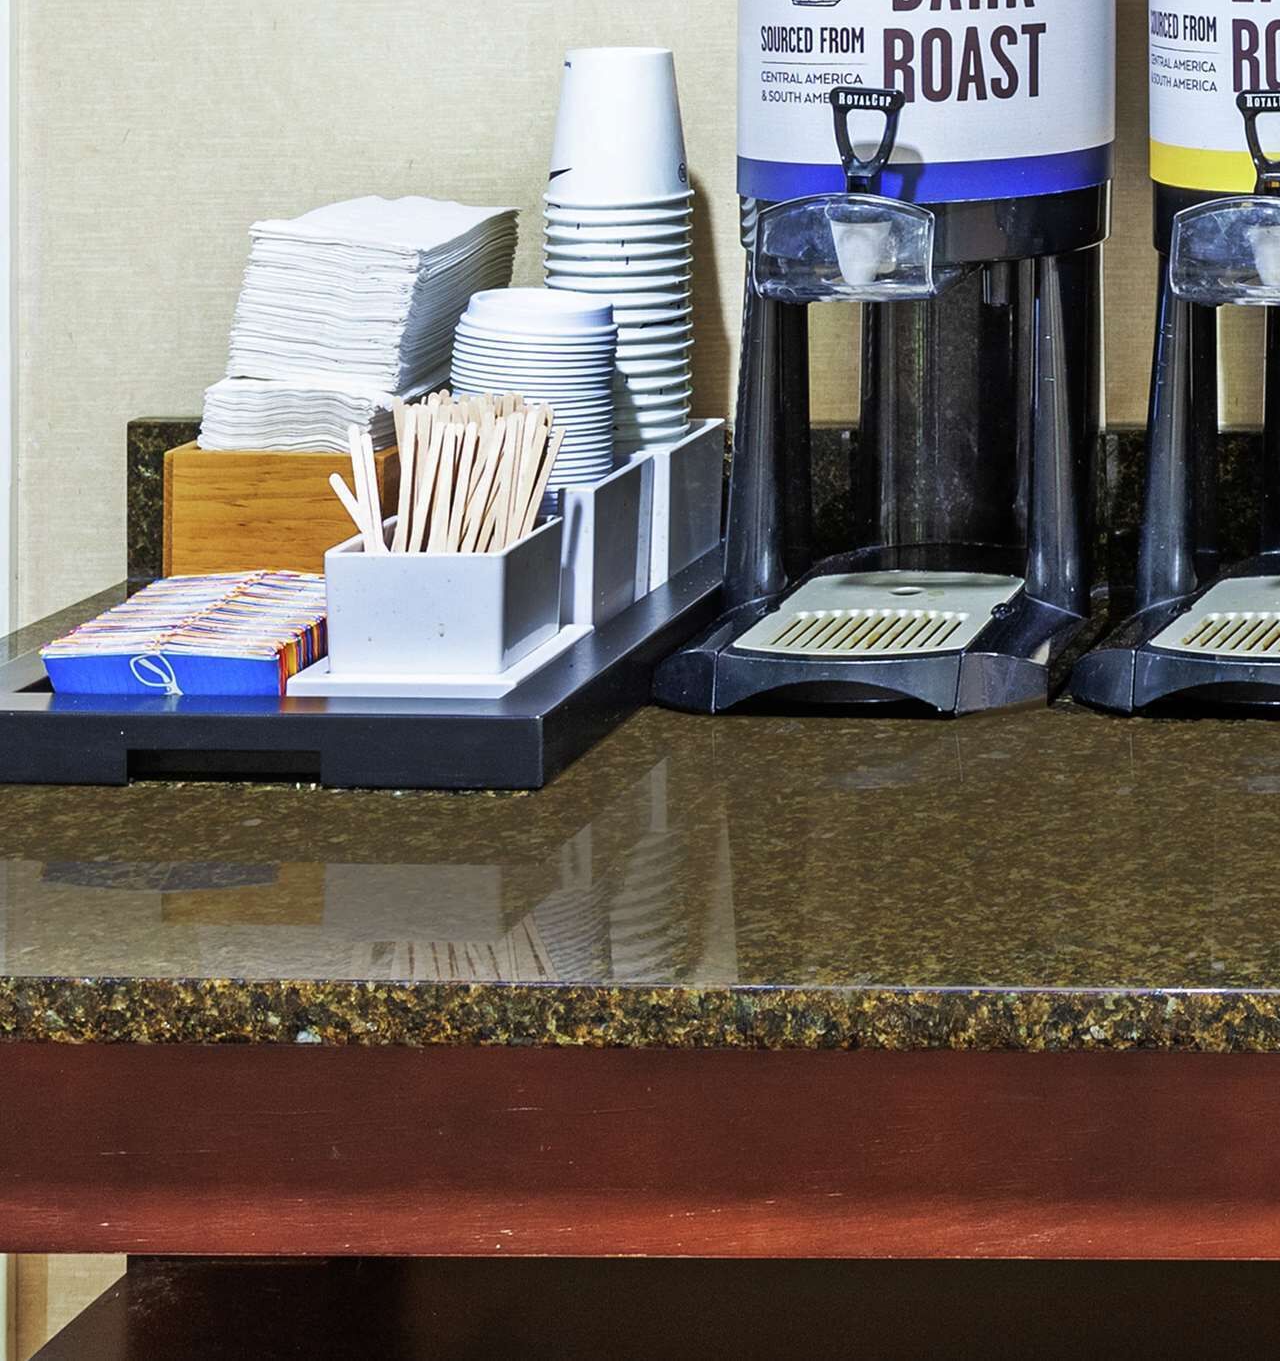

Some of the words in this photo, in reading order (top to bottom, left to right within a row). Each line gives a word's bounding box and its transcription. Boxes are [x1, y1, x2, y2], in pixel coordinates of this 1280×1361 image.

[1183, 14, 1217, 42] FROM
[761, 26, 812, 54] SOURCED
[820, 27, 865, 54] FROM
[883, 22, 1047, 103] ROAST
[1173, 59, 1216, 73] AMERICA
[761, 71, 802, 84] CENTRAL
[804, 72, 863, 85] AMERICA
[1173, 78, 1218, 92] AMERICA
[768, 91, 801, 103] SOUTH
